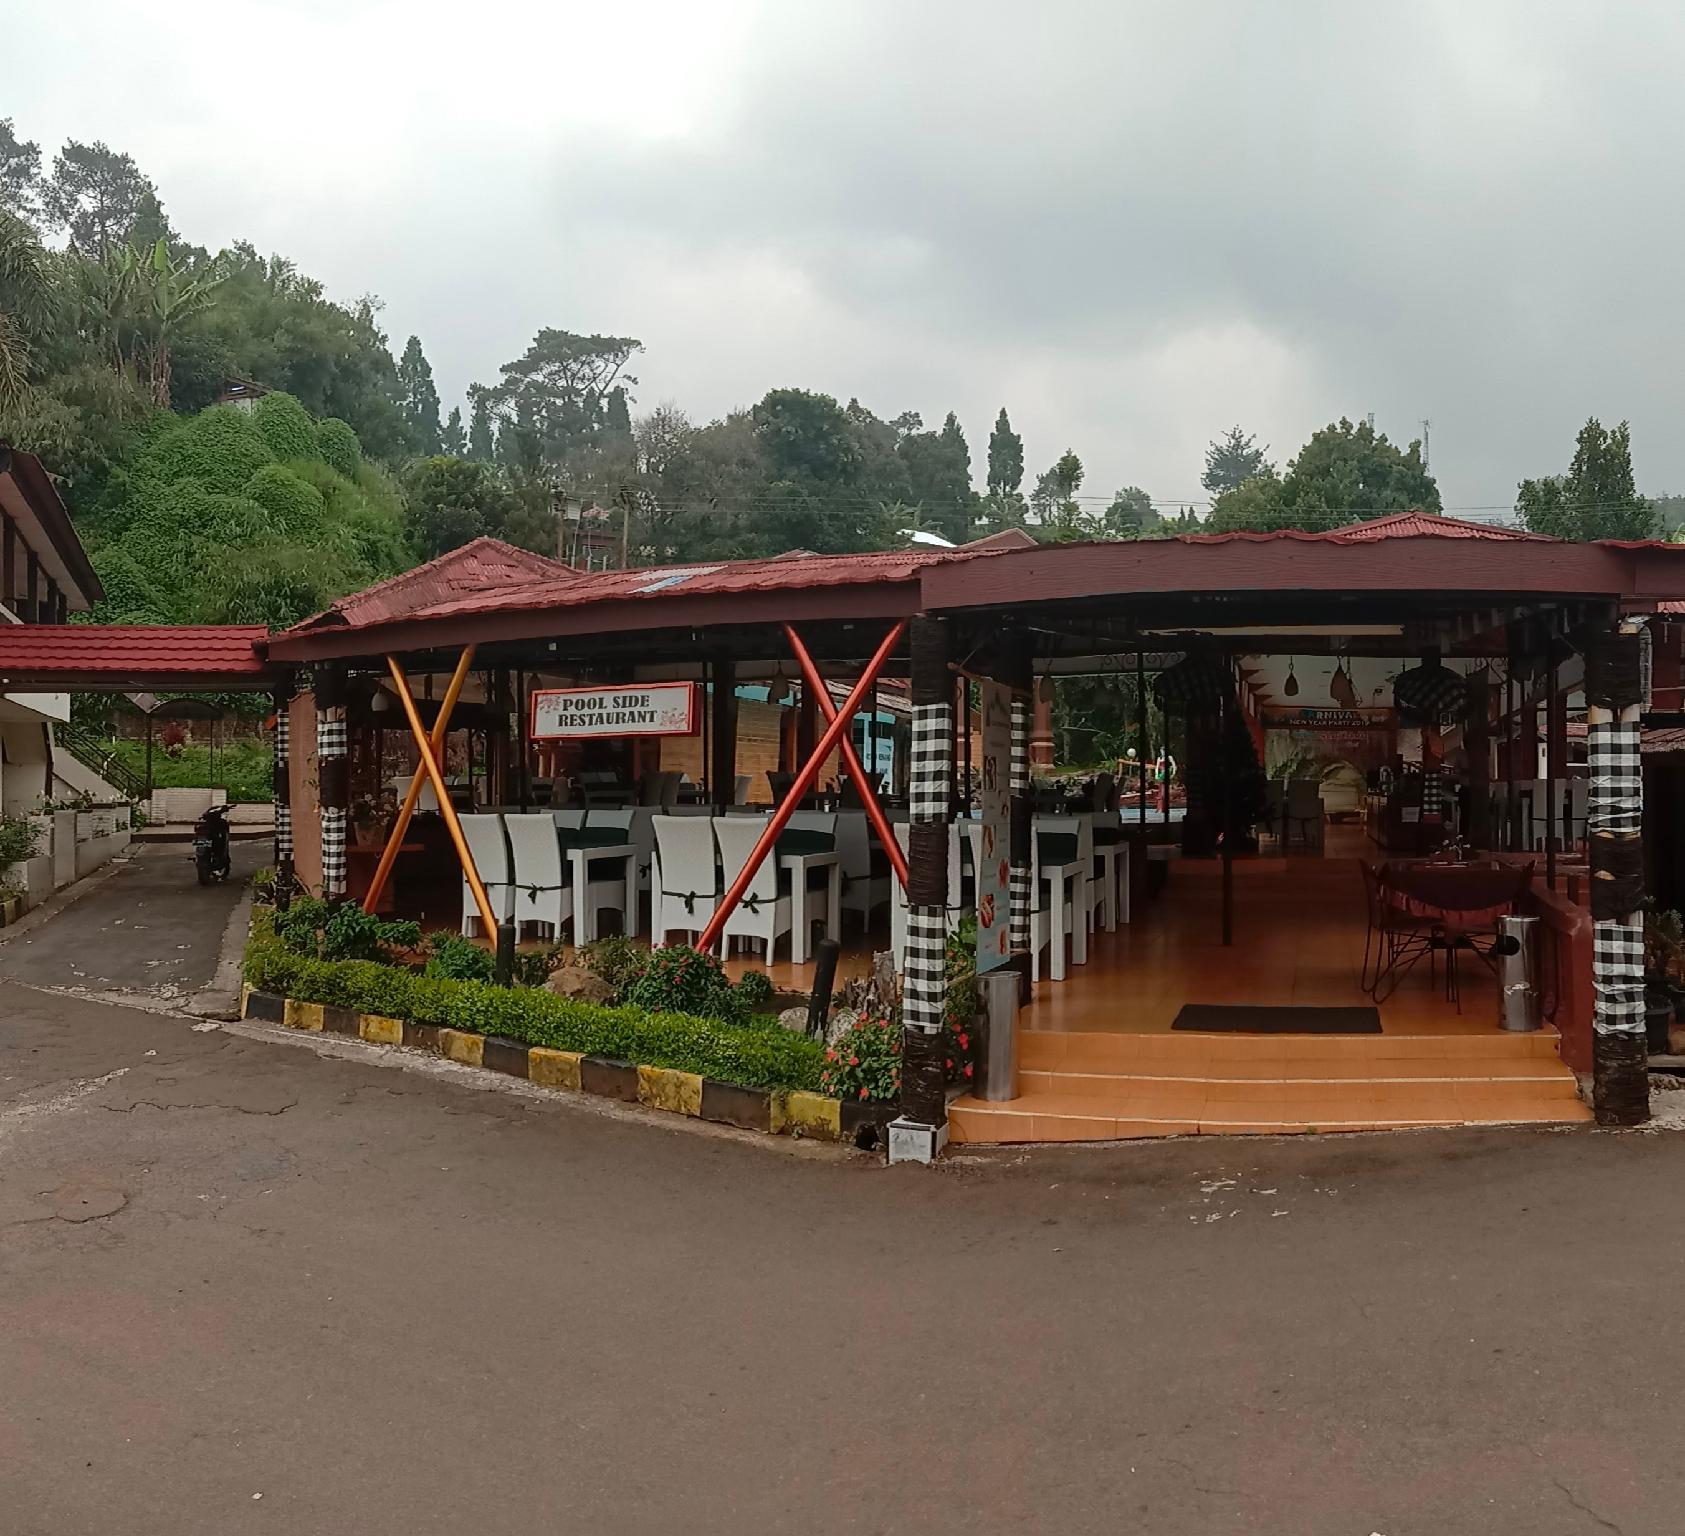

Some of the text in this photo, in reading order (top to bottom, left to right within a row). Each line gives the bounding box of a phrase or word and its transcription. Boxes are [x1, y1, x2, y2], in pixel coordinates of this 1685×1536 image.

[562, 695, 650, 711] POOL SIDE
[558, 710, 658, 727] RESTAURANT
